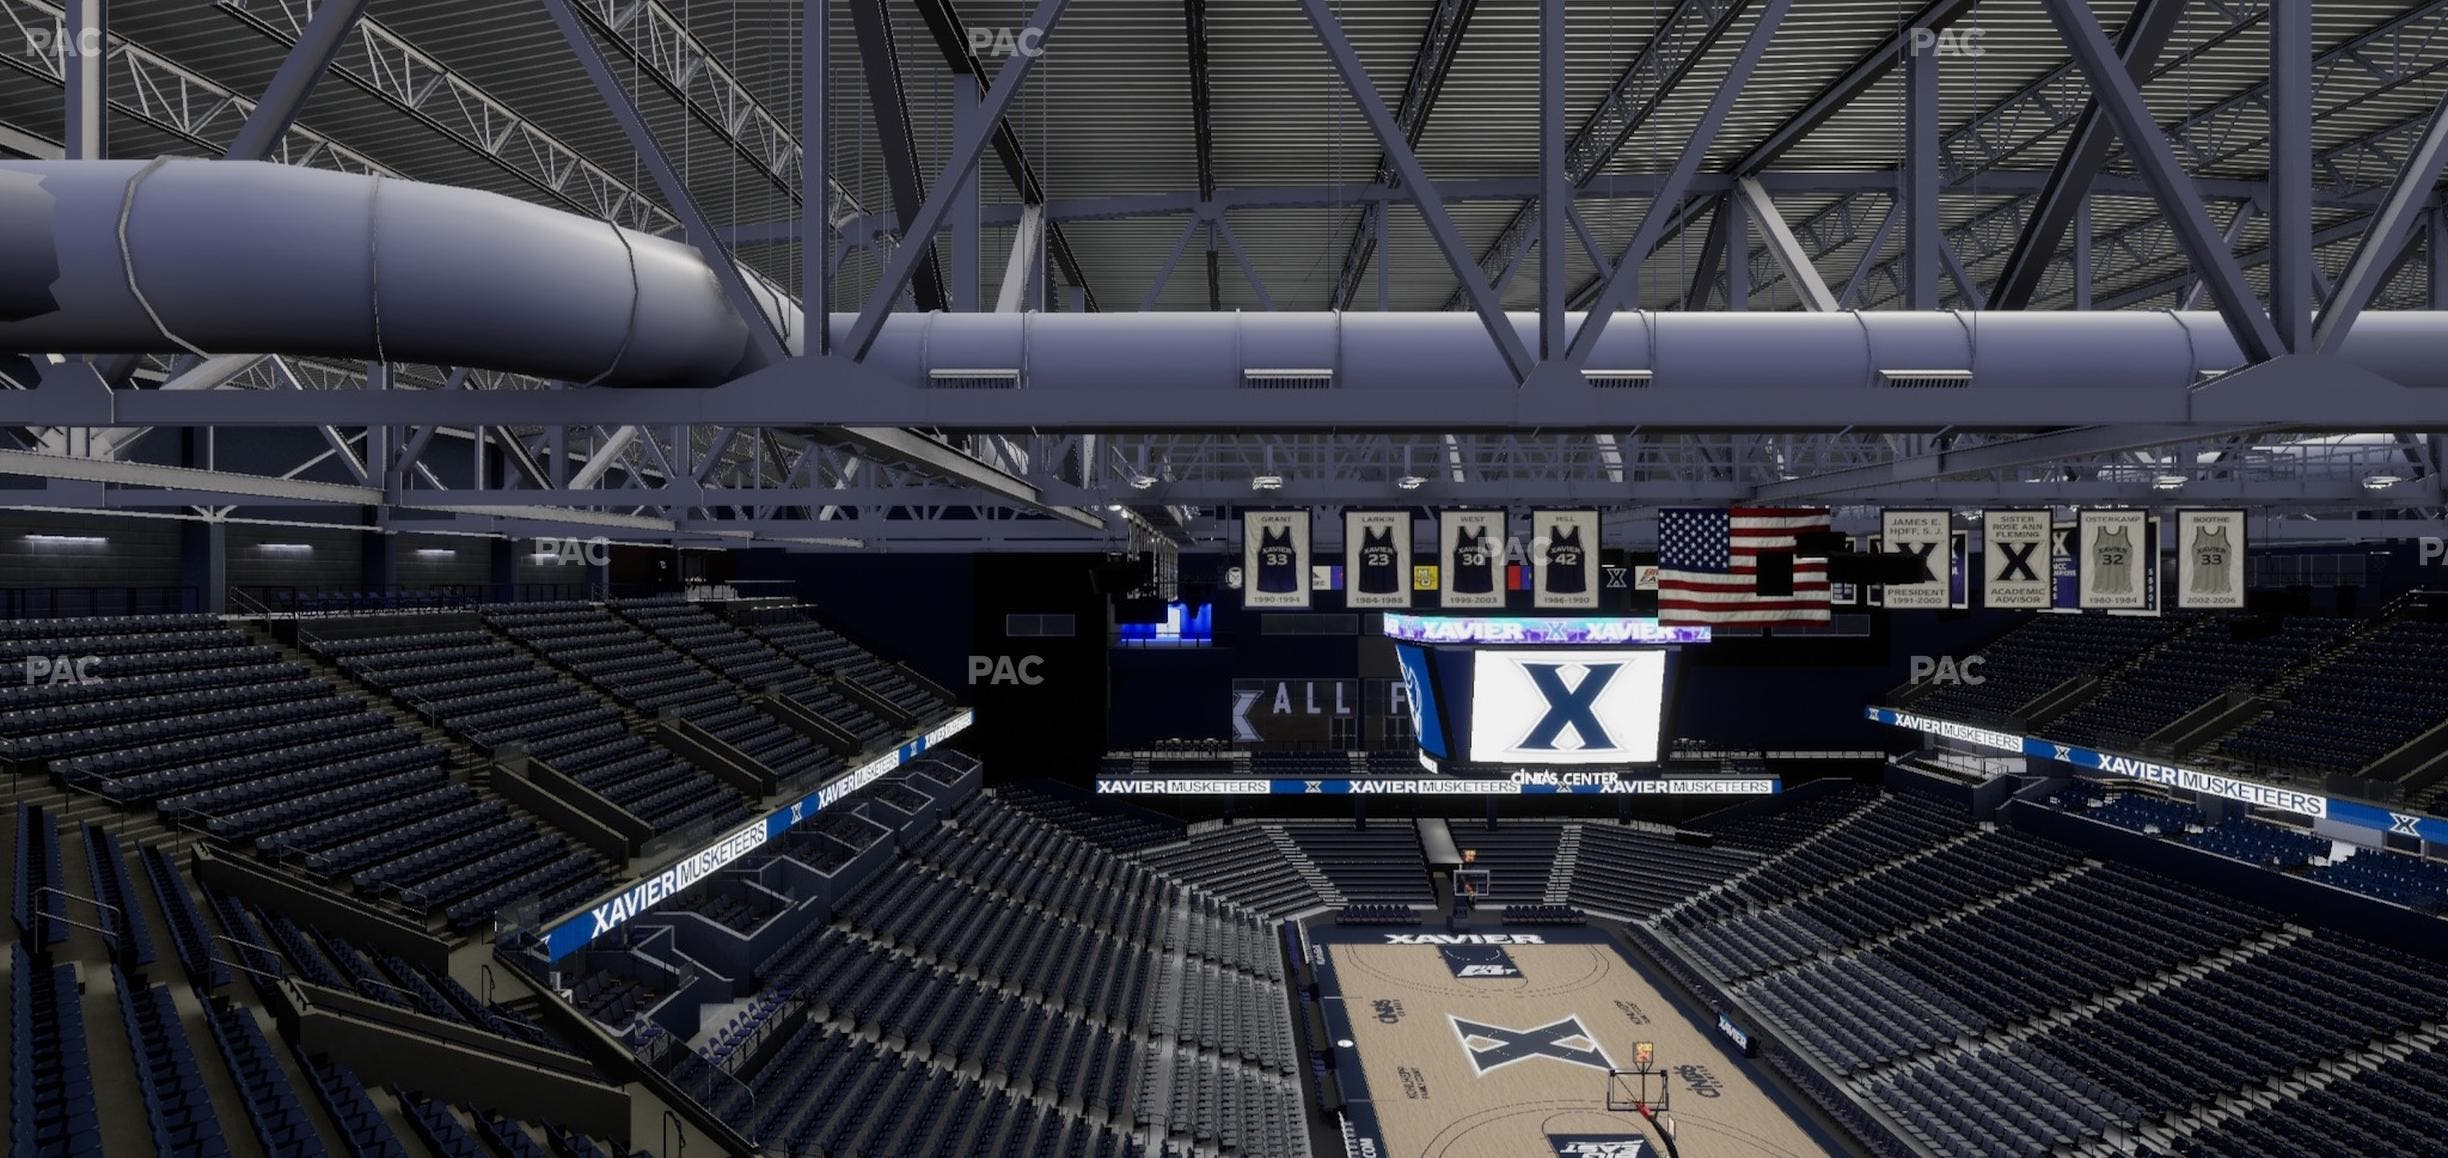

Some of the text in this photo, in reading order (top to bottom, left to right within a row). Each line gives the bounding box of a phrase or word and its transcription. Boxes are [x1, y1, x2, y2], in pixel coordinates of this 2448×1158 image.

[1891, 518, 1941, 526] JAMES E.
[1266, 553, 1289, 566] 33
[1368, 553, 1390, 566] 23
[1462, 553, 1485, 566] 30
[1555, 553, 1577, 566] 42
[2102, 554, 2124, 565] 32
[2201, 554, 2222, 565] 33
[1887, 588, 1945, 597] PRESIDENT
[1990, 588, 2045, 596] ACADEMIC
[1892, 597, 1942, 605] 1991-2000
[1996, 596, 2041, 604] ADVISOR
[2186, 596, 2237, 604] 2002-2006
[1423, 619, 1526, 640] XAVIER
[1587, 621, 1677, 640] XAVIER
[1272, 681, 1351, 715] ALL
[1510, 660, 1630, 752] X
[1895, 712, 1942, 736] XAVIER
[1944, 724, 2020, 750] MUSKETEERS
[1563, 771, 1619, 786] CENTER
[2098, 753, 2178, 786] XAVIER
[2182, 770, 2322, 816] MUSKETEERS
[818, 775, 856, 810] XAVIER
[1097, 780, 1166, 794] XAVIER
[1171, 781, 1268, 793] MUSKETEERS
[1349, 780, 1417, 794] XAVIER
[1421, 781, 1518, 793] MUSKETEERS
[1600, 780, 1669, 794] XAVIER
[1673, 781, 1769, 793] MUSKETEERS
[591, 821, 766, 940] XAVIER MUSKETEERS
[1384, 934, 1545, 945] XAVIER
[1718, 1013, 1748, 1050] XAVIER
